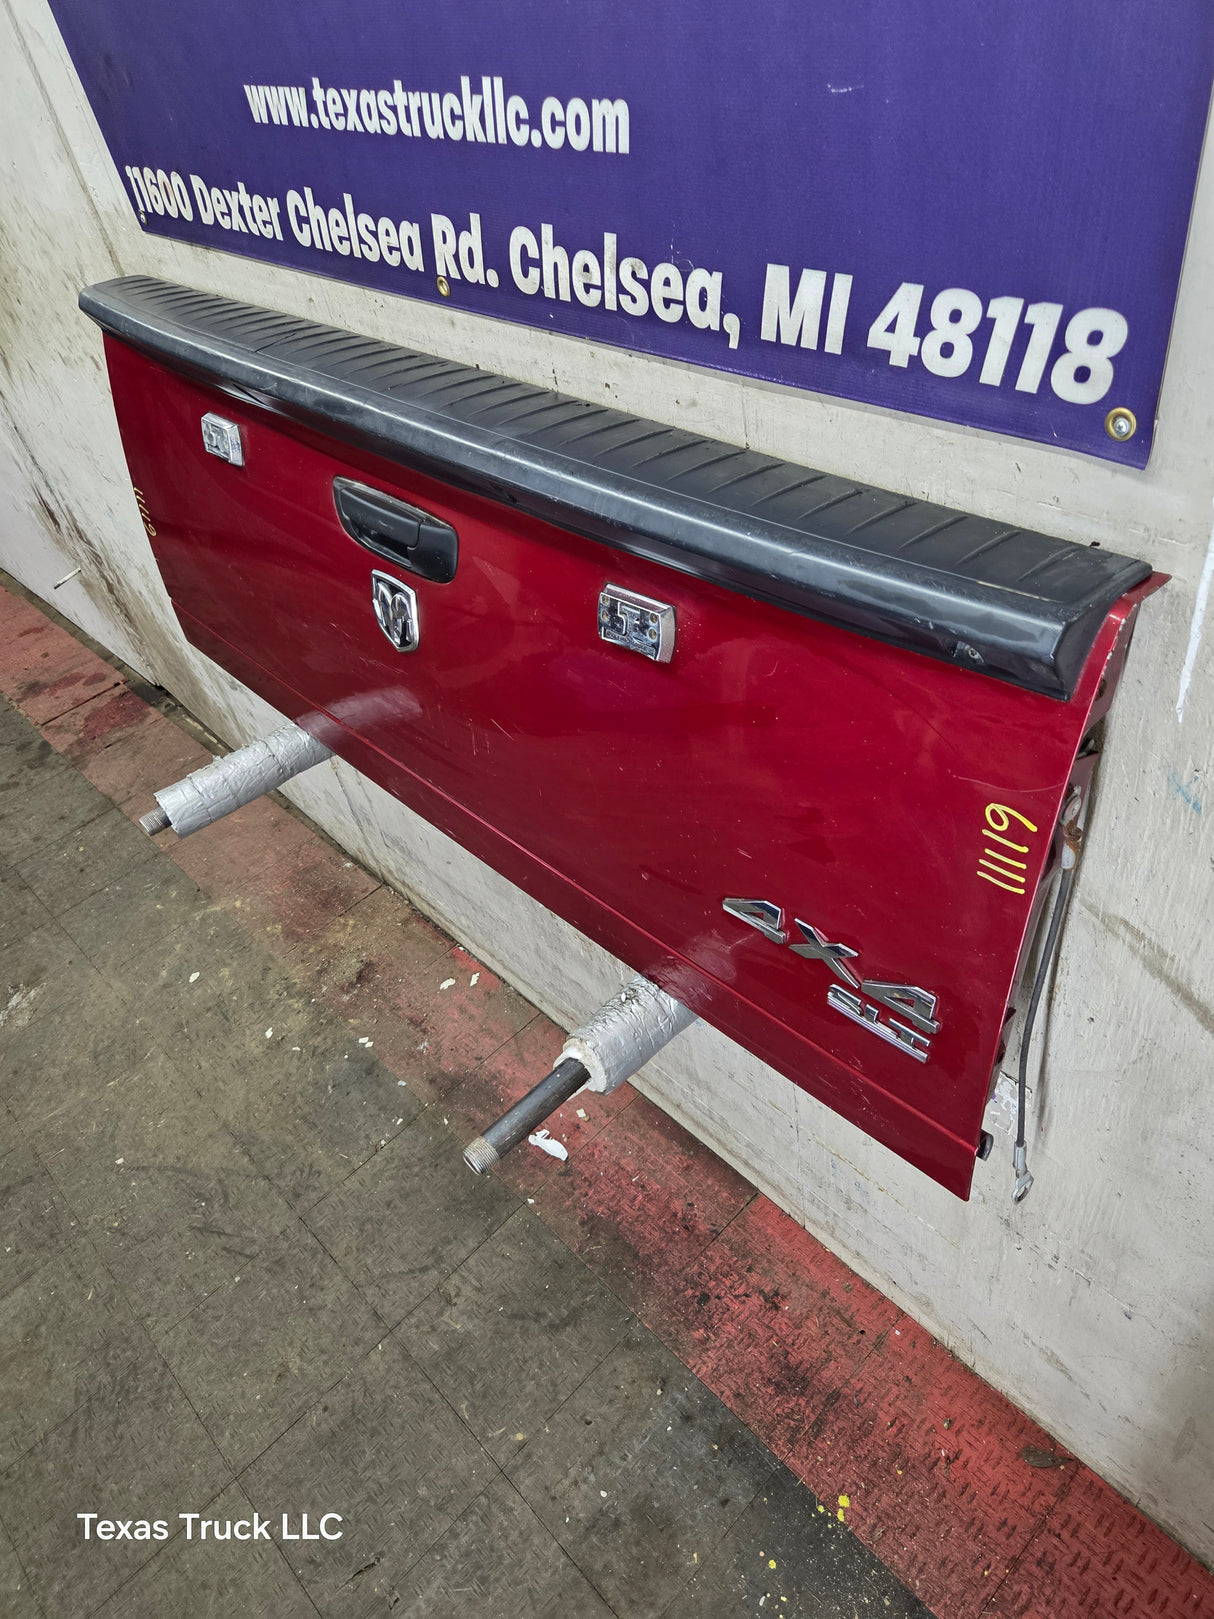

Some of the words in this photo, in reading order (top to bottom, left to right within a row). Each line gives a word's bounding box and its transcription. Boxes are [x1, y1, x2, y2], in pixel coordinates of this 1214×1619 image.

[244, 75, 630, 154] www.texastruckllc.com
[125, 166, 194, 226] 11600
[190, 174, 284, 242] Dexter
[286, 187, 426, 274] Chelsea
[432, 213, 500, 288] Rd.
[509, 223, 741, 350] Chelsea,
[760, 263, 854, 355] MI
[866, 282, 1129, 405] 48118
